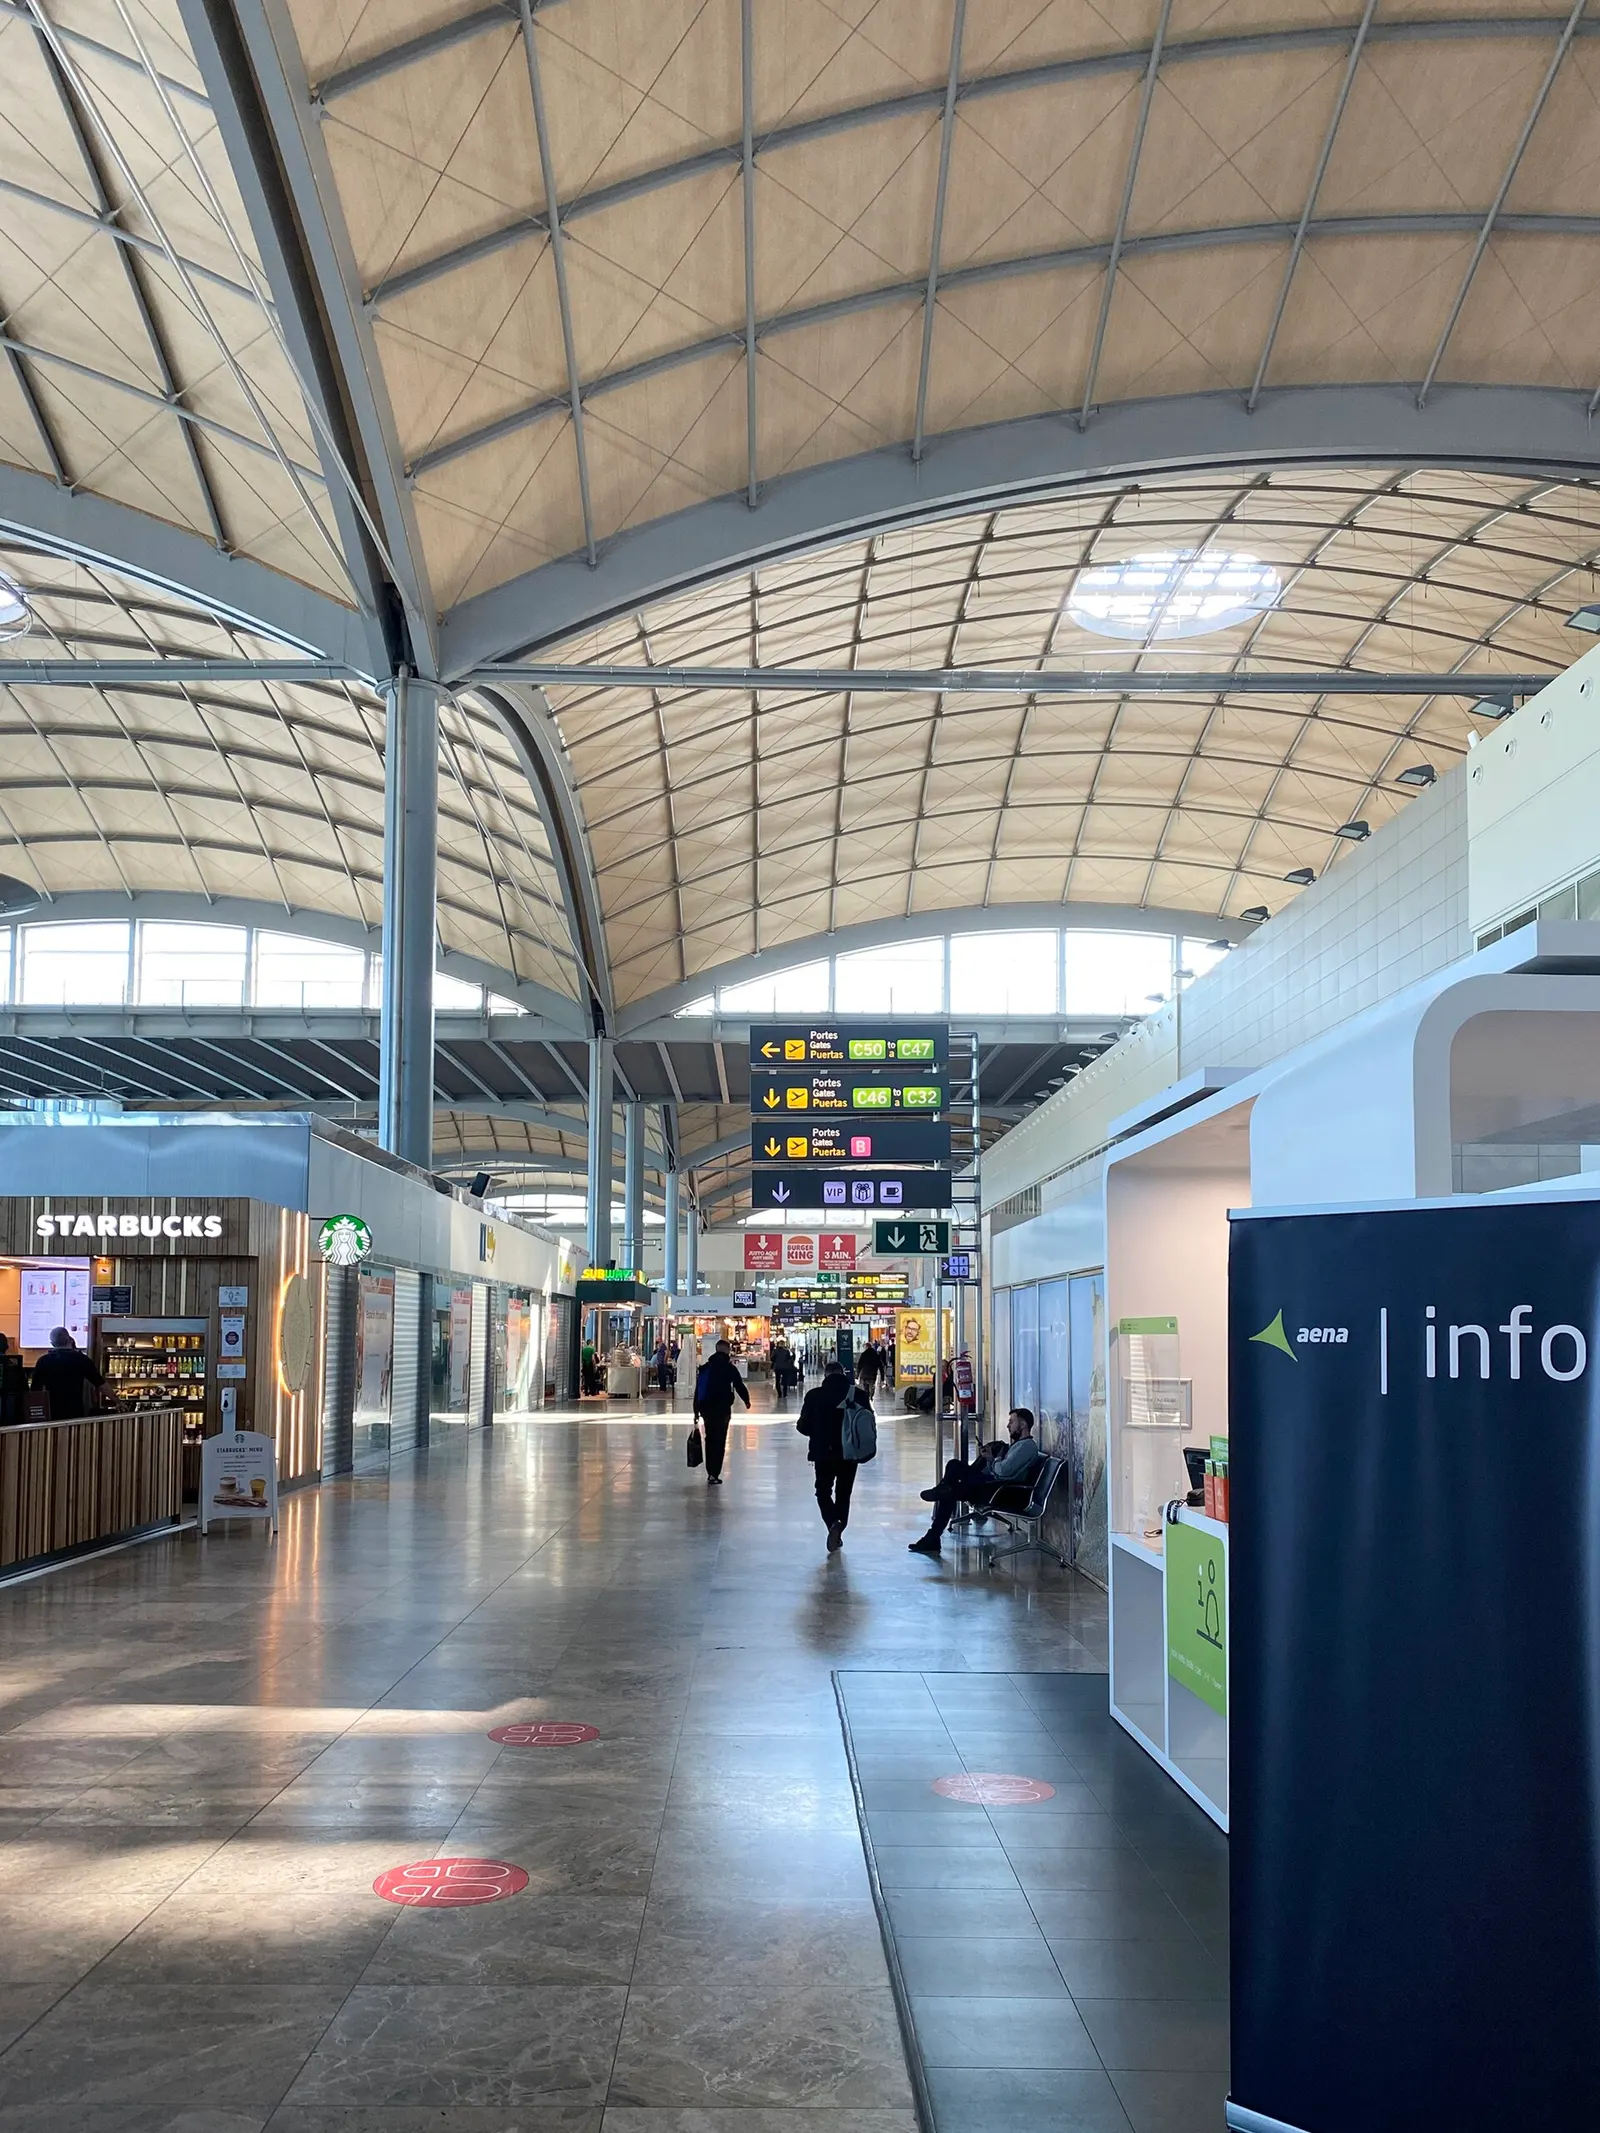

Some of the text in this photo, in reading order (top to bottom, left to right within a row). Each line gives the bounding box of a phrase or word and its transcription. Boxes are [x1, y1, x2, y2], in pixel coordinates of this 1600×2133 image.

[810, 1030, 838, 1040] Portes
[810, 1041, 831, 1050] Gates
[853, 1041, 931, 1057] C50 to C47
[810, 1050, 844, 1059] Puertas
[812, 1078, 841, 1088] Portes
[812, 1089, 836, 1098] Gates
[856, 1088, 937, 1105] C46 to C32
[812, 1099, 848, 1108] Puertas
[812, 1128, 840, 1137] Portes
[812, 1138, 833, 1147] Gates
[855, 1140, 866, 1153] B
[812, 1147, 846, 1157] Puertas
[826, 1187, 844, 1197] VIP
[36, 1214, 223, 1238] STARBUCKS
[787, 1251, 814, 1260] KING
[824, 1251, 852, 1259] 3 MIN.
[581, 1268, 633, 1279] SUBWAY
[1296, 1304, 1588, 1382] aena info
[900, 1364, 937, 1376] MEDIC
